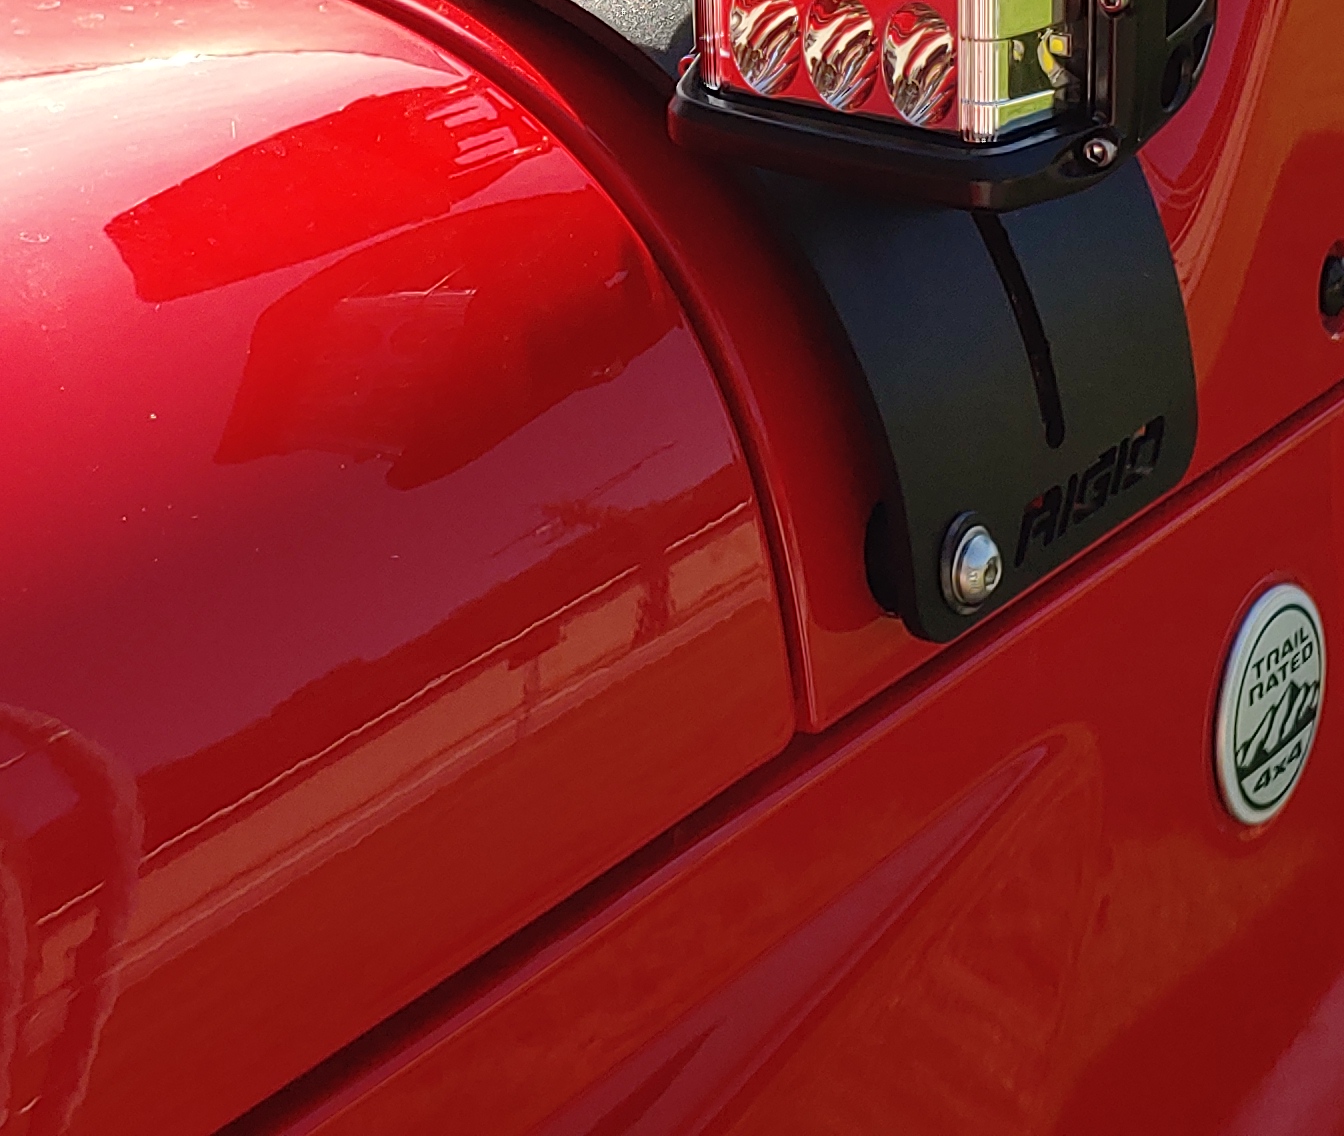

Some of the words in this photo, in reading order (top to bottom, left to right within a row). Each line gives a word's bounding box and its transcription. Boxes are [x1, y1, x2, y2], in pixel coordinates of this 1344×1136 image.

[1014, 415, 1165, 568] RIGID
[1248, 640, 1314, 707] RATED
[1251, 626, 1310, 680] TRAIL
